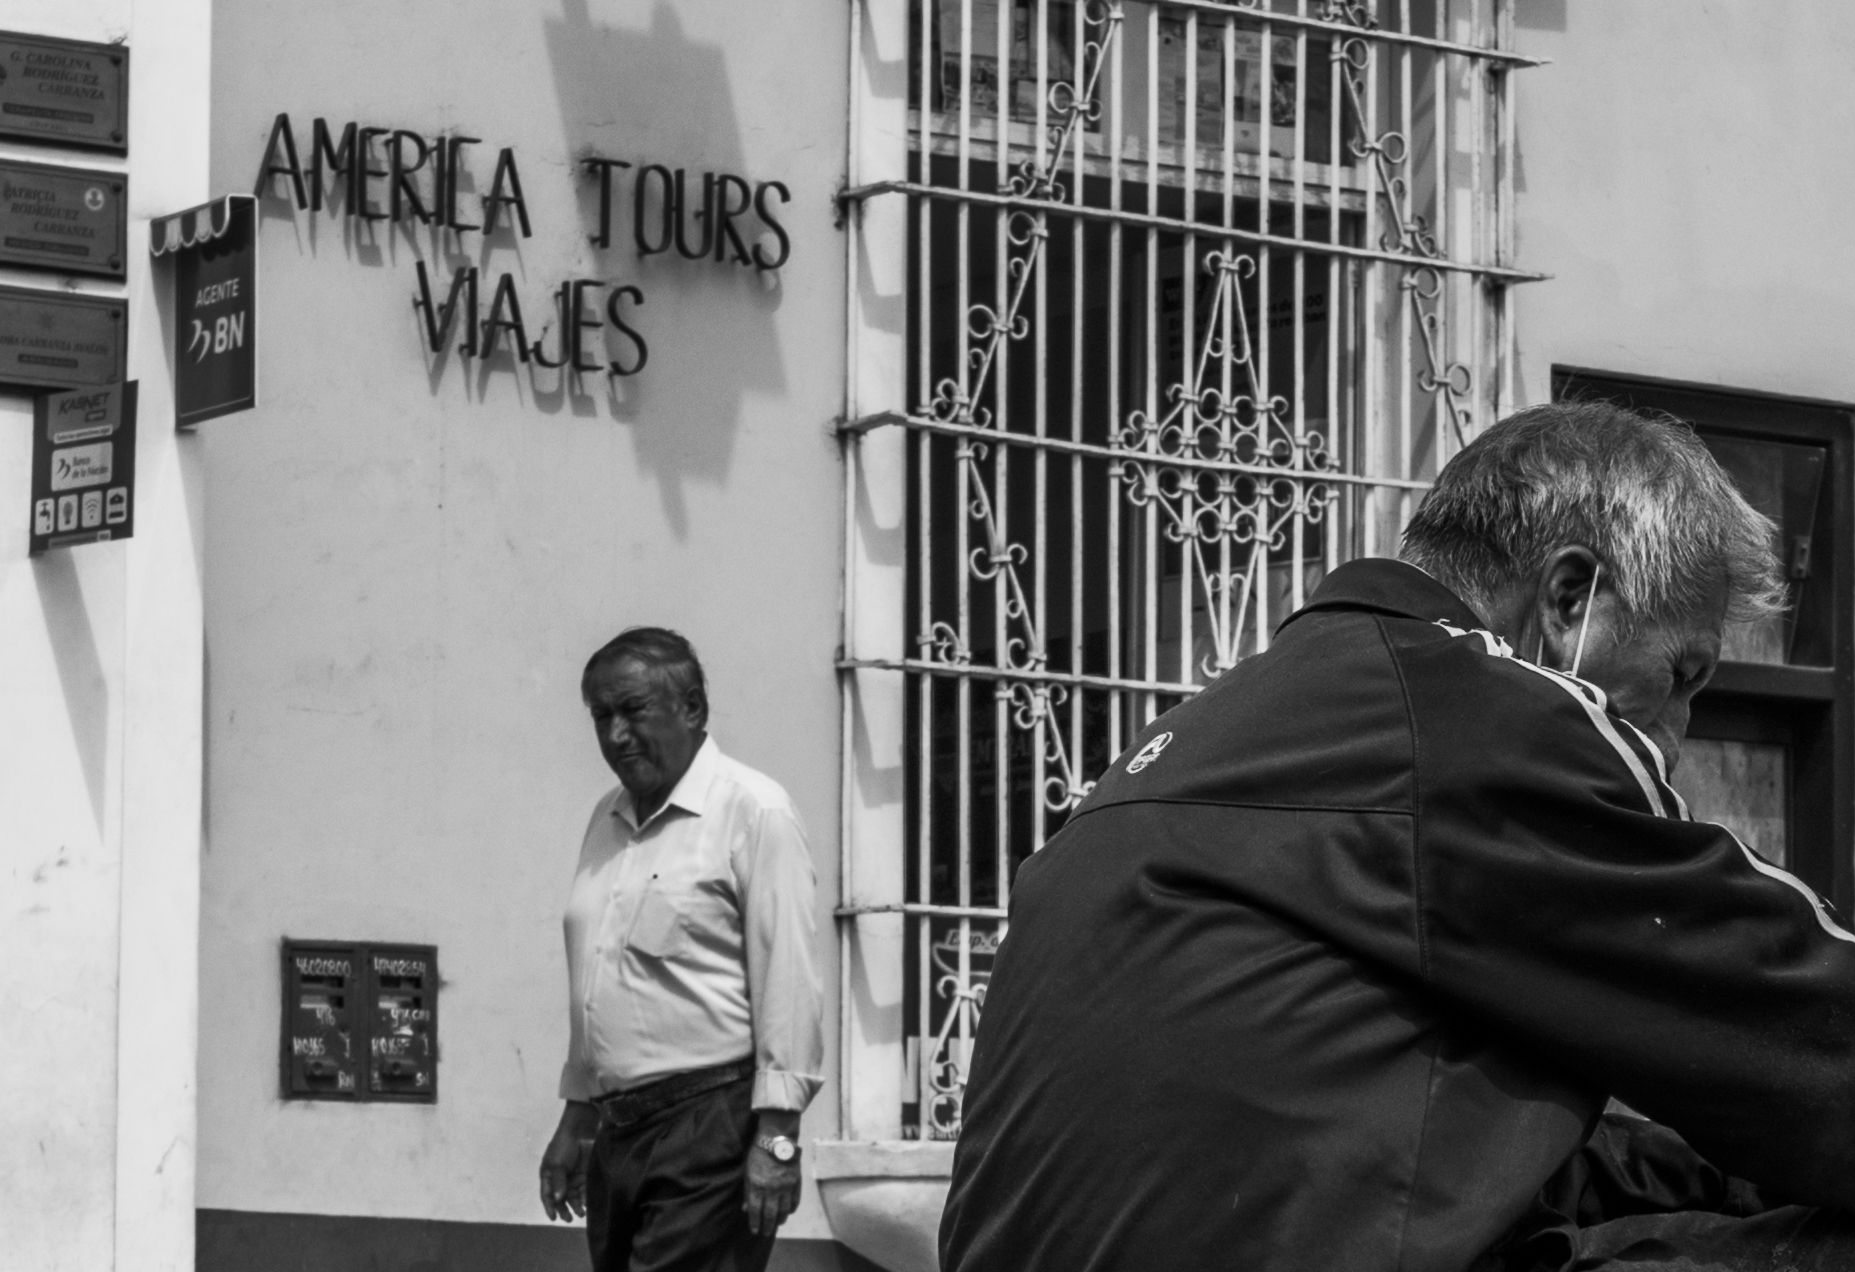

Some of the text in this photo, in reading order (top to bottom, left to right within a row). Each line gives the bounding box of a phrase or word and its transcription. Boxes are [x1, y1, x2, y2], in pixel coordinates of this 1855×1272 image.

[255, 112, 792, 271] AMERICA TOURS
[196, 278, 241, 308] AGENTE
[213, 311, 246, 355] BN
[415, 260, 649, 377] VIAJES
